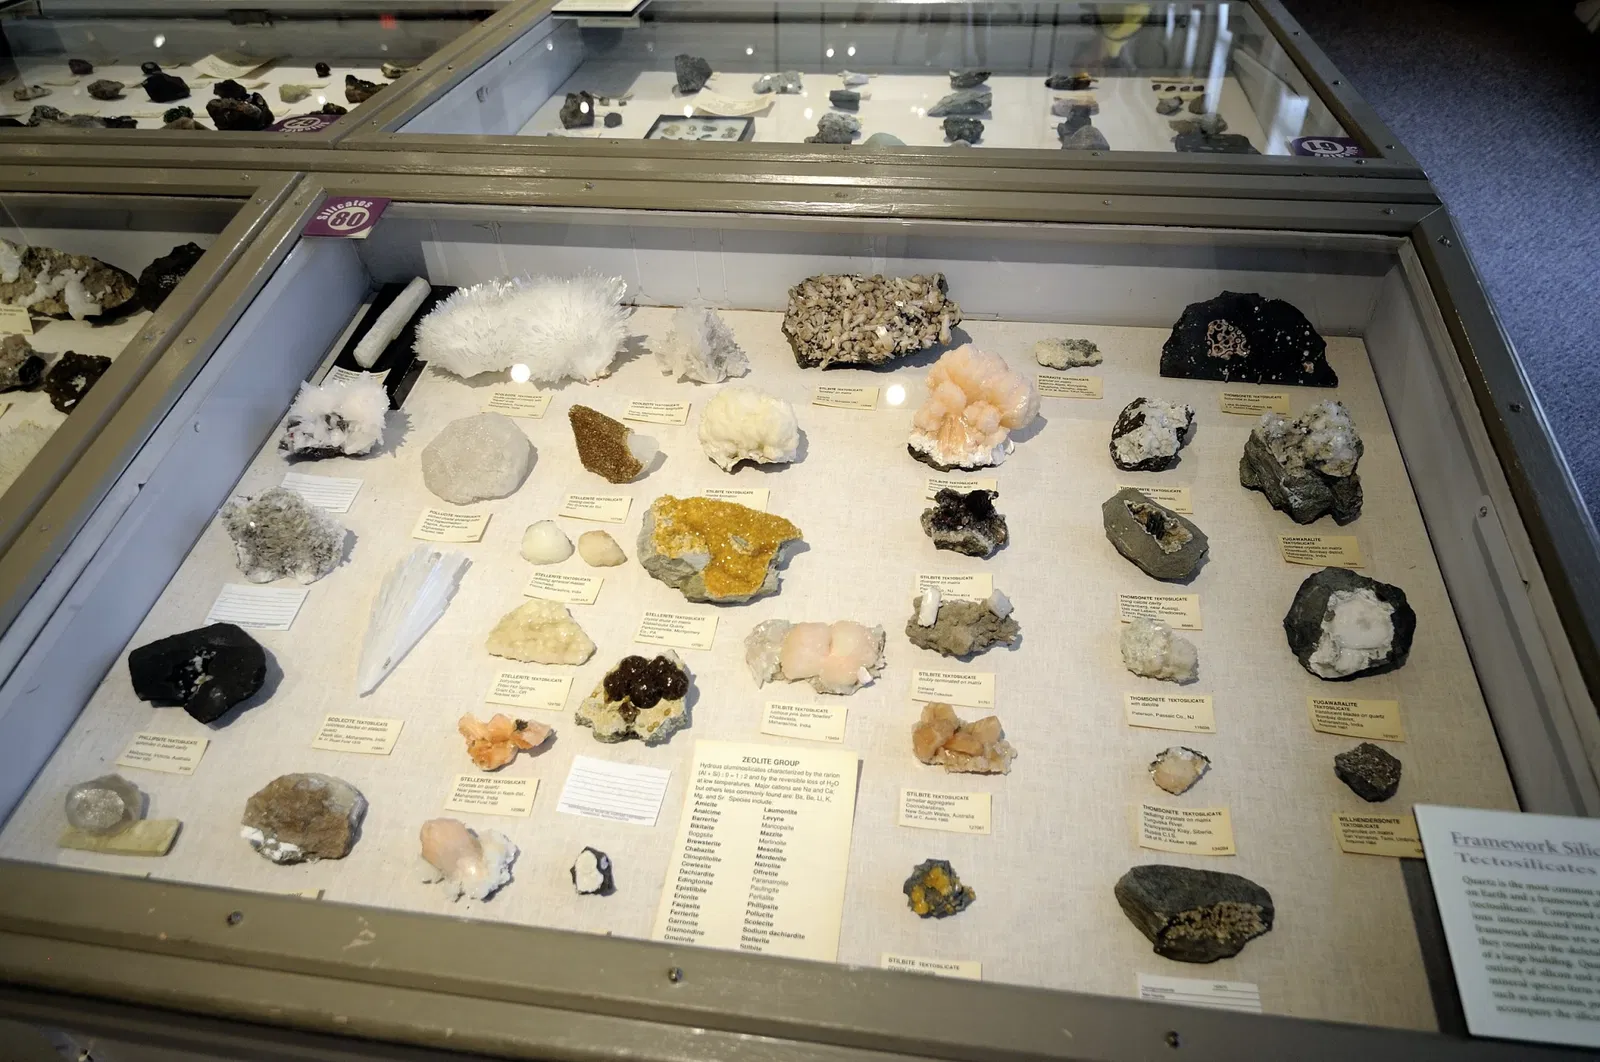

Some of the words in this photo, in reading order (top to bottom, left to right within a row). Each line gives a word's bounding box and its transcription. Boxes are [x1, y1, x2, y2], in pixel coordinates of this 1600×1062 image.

[316, 200, 373, 220] Silicates
[330, 212, 366, 226] 80
[742, 756, 772, 765] ZEOLITE
[736, 789, 764, 797] commonly
[693, 808, 721, 816] Analcime
[764, 807, 798, 815] Laumontite
[1143, 805, 1178, 815] THOMSONITE
[692, 815, 718, 823] Barrerite
[763, 815, 785, 823] Levyne
[690, 823, 715, 831] Bikitaite
[760, 830, 783, 838] Mazzite
[687, 838, 722, 847] Brewsterite
[1451, 831, 1558, 854] Framework
[685, 846, 715, 854] Chabazite
[757, 846, 783, 854] Mesolite
[756, 854, 787, 862] Mordenite
[681, 861, 711, 869] Cowlesite
[754, 861, 781, 869] Natrolite
[1454, 851, 1597, 875] Tectosilicates
[679, 868, 715, 878] Dachiardite
[753, 869, 779, 877] Offretite
[678, 876, 714, 886] Edingtonite
[1462, 875, 1496, 886] Quartz
[1498, 879, 1506, 887] is
[1508, 880, 1523, 889] the
[1526, 884, 1550, 892] most
[675, 884, 707, 894] Epistilbite
[674, 892, 699, 901] Erionite
[1480, 889, 1506, 899] Earth
[1537, 895, 1590, 907] framework
[672, 901, 701, 910] Faujasite
[747, 901, 779, 911] Phillipsite
[670, 909, 699, 918] Ferrierite
[746, 910, 774, 919] Pollucite
[668, 917, 698, 926] Garronite
[744, 918, 774, 927] Scolecite
[666, 926, 705, 936] Gismondine
[743, 927, 768, 936] Sodium
[769, 930, 806, 940] dachiardite
[664, 934, 695, 943] Gmelinite
[741, 935, 770, 944] Stellerite
[919, 962, 960, 970] TEKTOSILICATE
